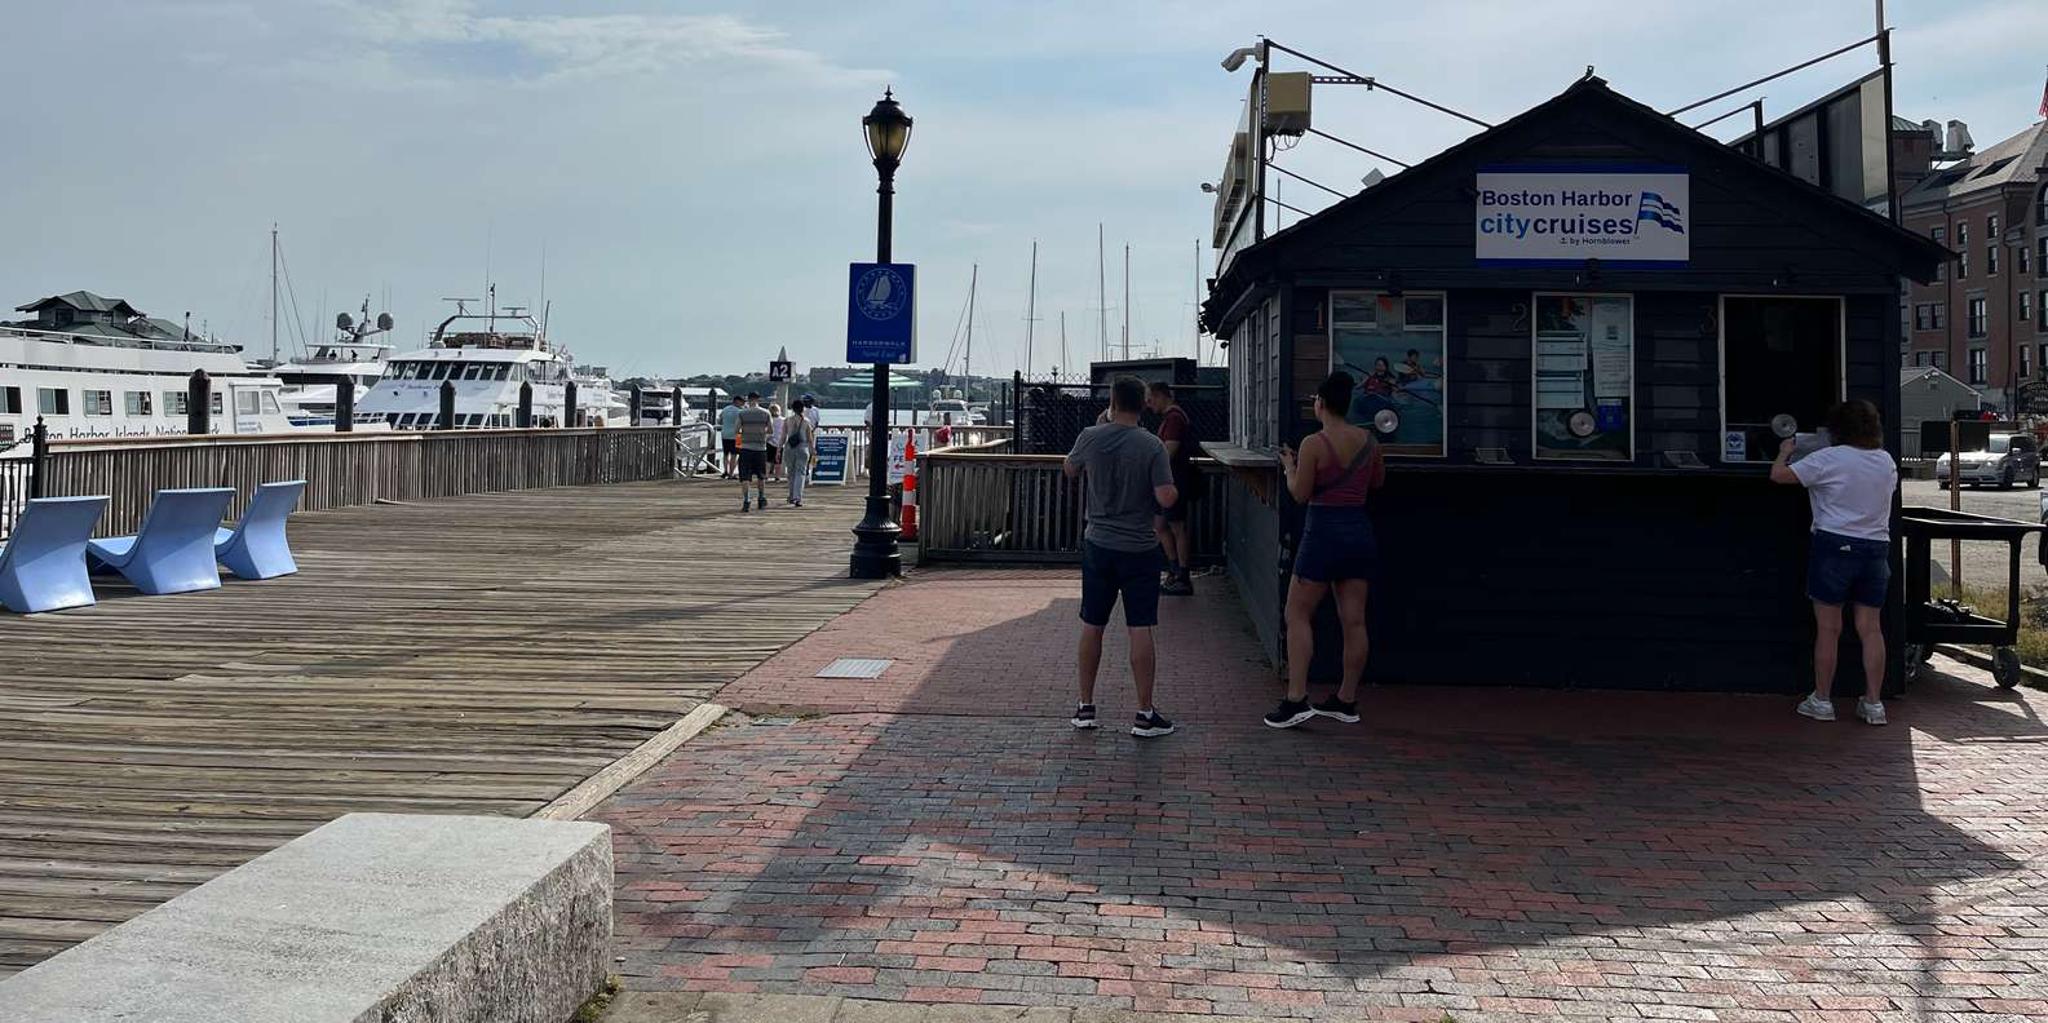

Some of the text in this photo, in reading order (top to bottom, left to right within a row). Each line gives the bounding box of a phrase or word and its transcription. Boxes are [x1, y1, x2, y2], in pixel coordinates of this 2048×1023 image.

[1482, 190, 1633, 206] Boston Harbor
[1570, 237, 1579, 245] by
[1582, 237, 1631, 245] Hornblower
[1511, 303, 1528, 332] 2
[772, 364, 788, 377] A2
[25, 427, 63, 441] Bton
